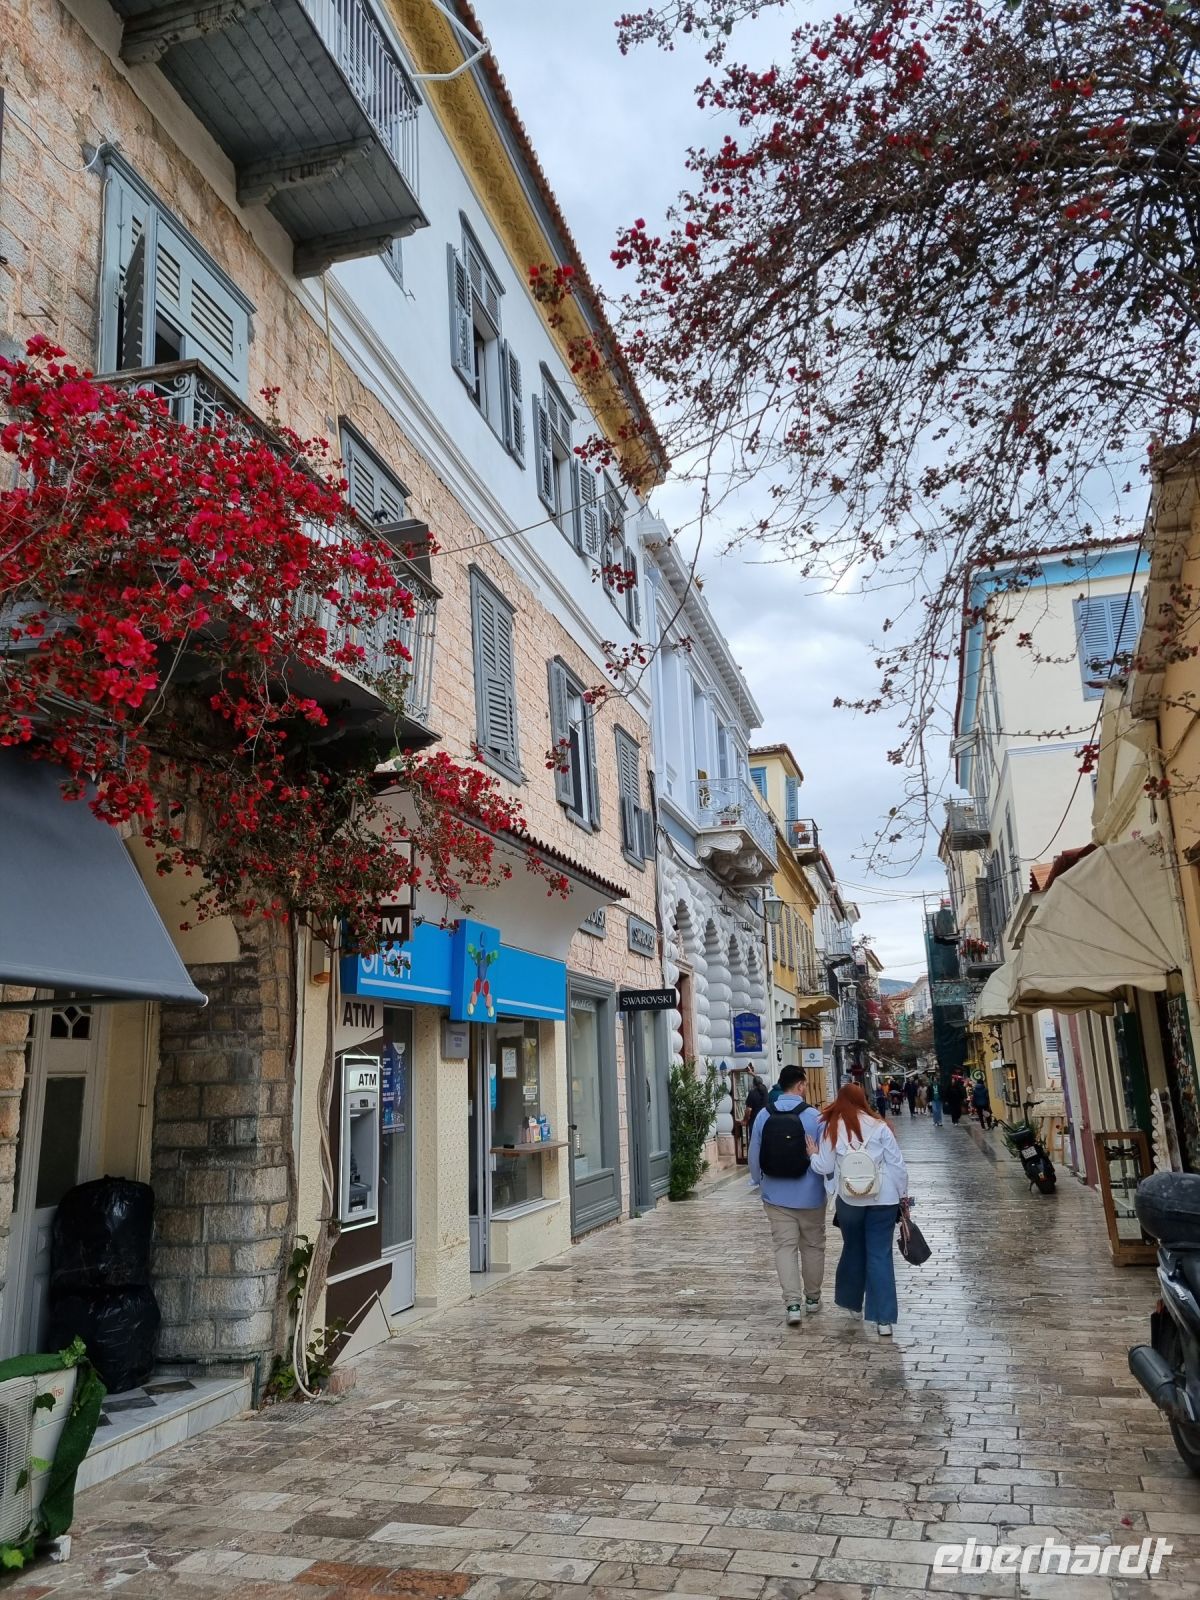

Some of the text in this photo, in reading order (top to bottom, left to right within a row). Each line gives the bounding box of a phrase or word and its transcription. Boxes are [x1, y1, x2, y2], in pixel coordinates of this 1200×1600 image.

[622, 995, 672, 1006] SWAROVSKI
[342, 1002, 375, 1029] ATM
[358, 1073, 377, 1086] ATM
